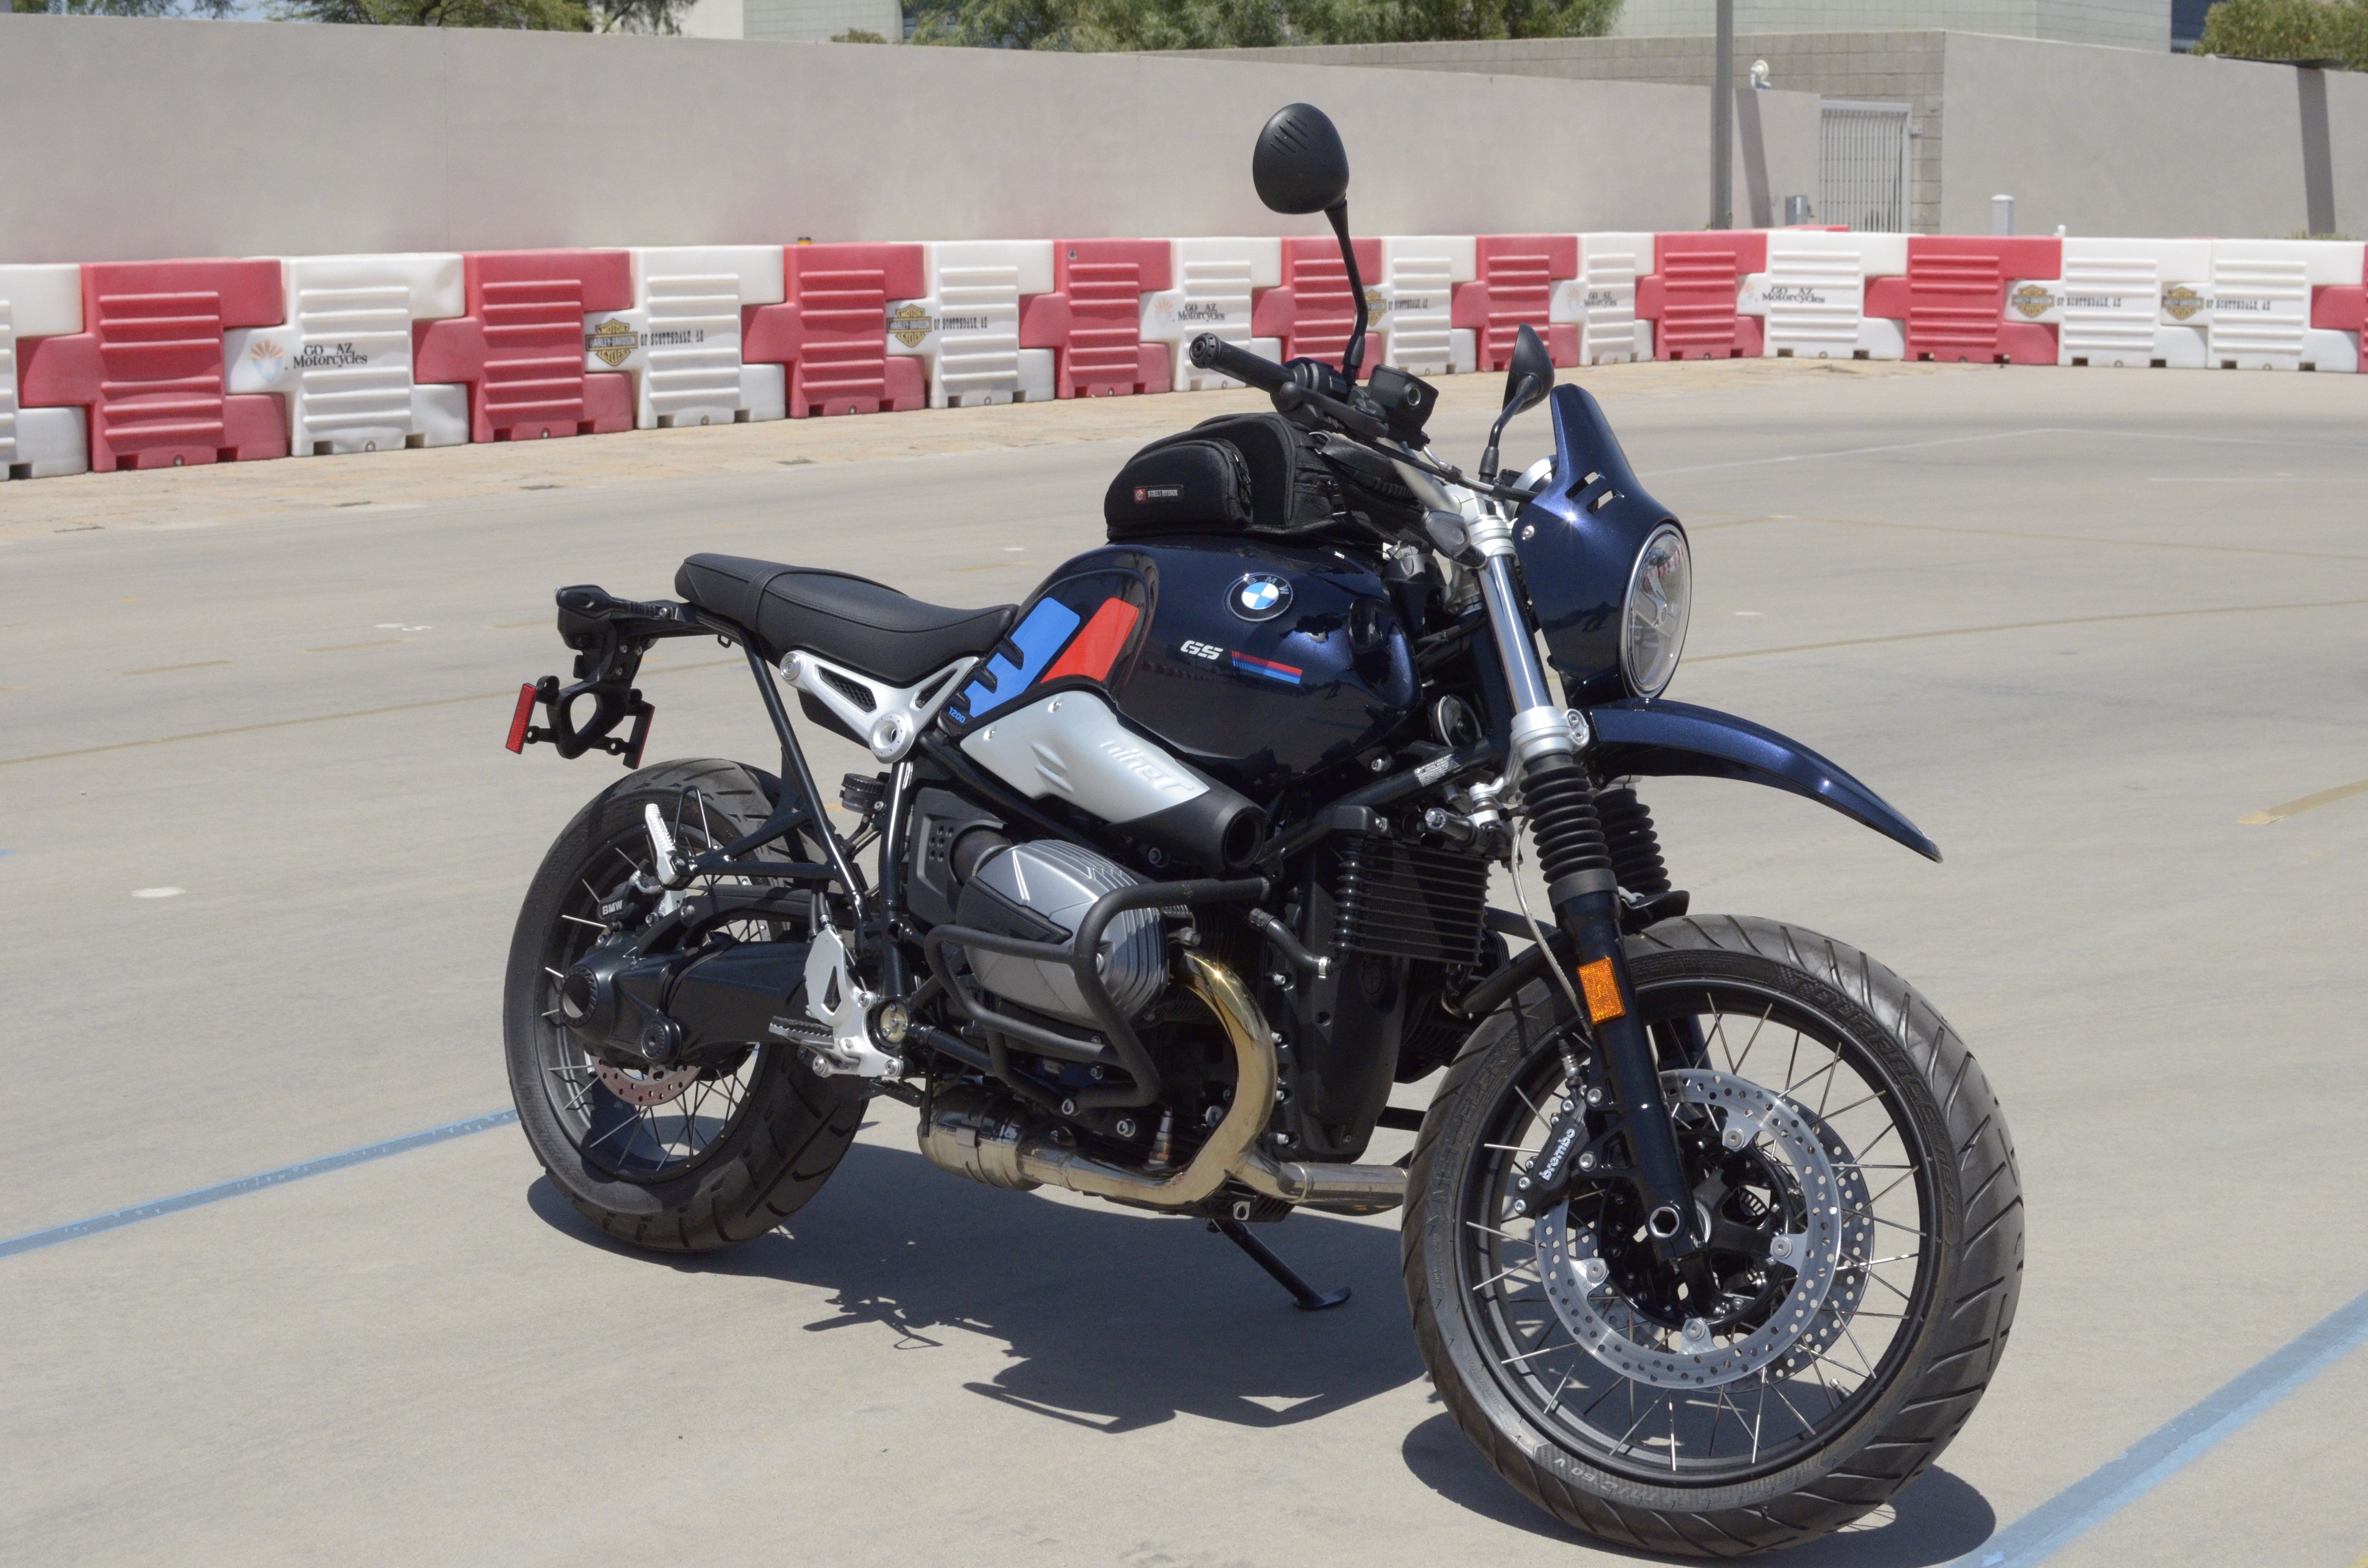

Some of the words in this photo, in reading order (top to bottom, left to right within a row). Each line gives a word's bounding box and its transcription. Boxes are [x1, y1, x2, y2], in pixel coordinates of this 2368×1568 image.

[1762, 293, 1825, 304] Motorcycles
[1185, 304, 1197, 312] GO
[1205, 303, 1217, 312] AZ
[1178, 310, 1225, 322] Motorcycles
[641, 333, 647, 346] OF
[651, 330, 693, 346] SCOTTSDALE,
[696, 330, 703, 343] AZ
[304, 344, 324, 357] GO
[336, 343, 352, 354] AZ
[293, 351, 368, 369] Motorcycles
[1246, 576, 1289, 595] BMW
[1180, 640, 1223, 660] GS
[949, 706, 966, 723] 1200
[602, 900, 622, 915] BMW
[1538, 1128, 1576, 1181] brembo
